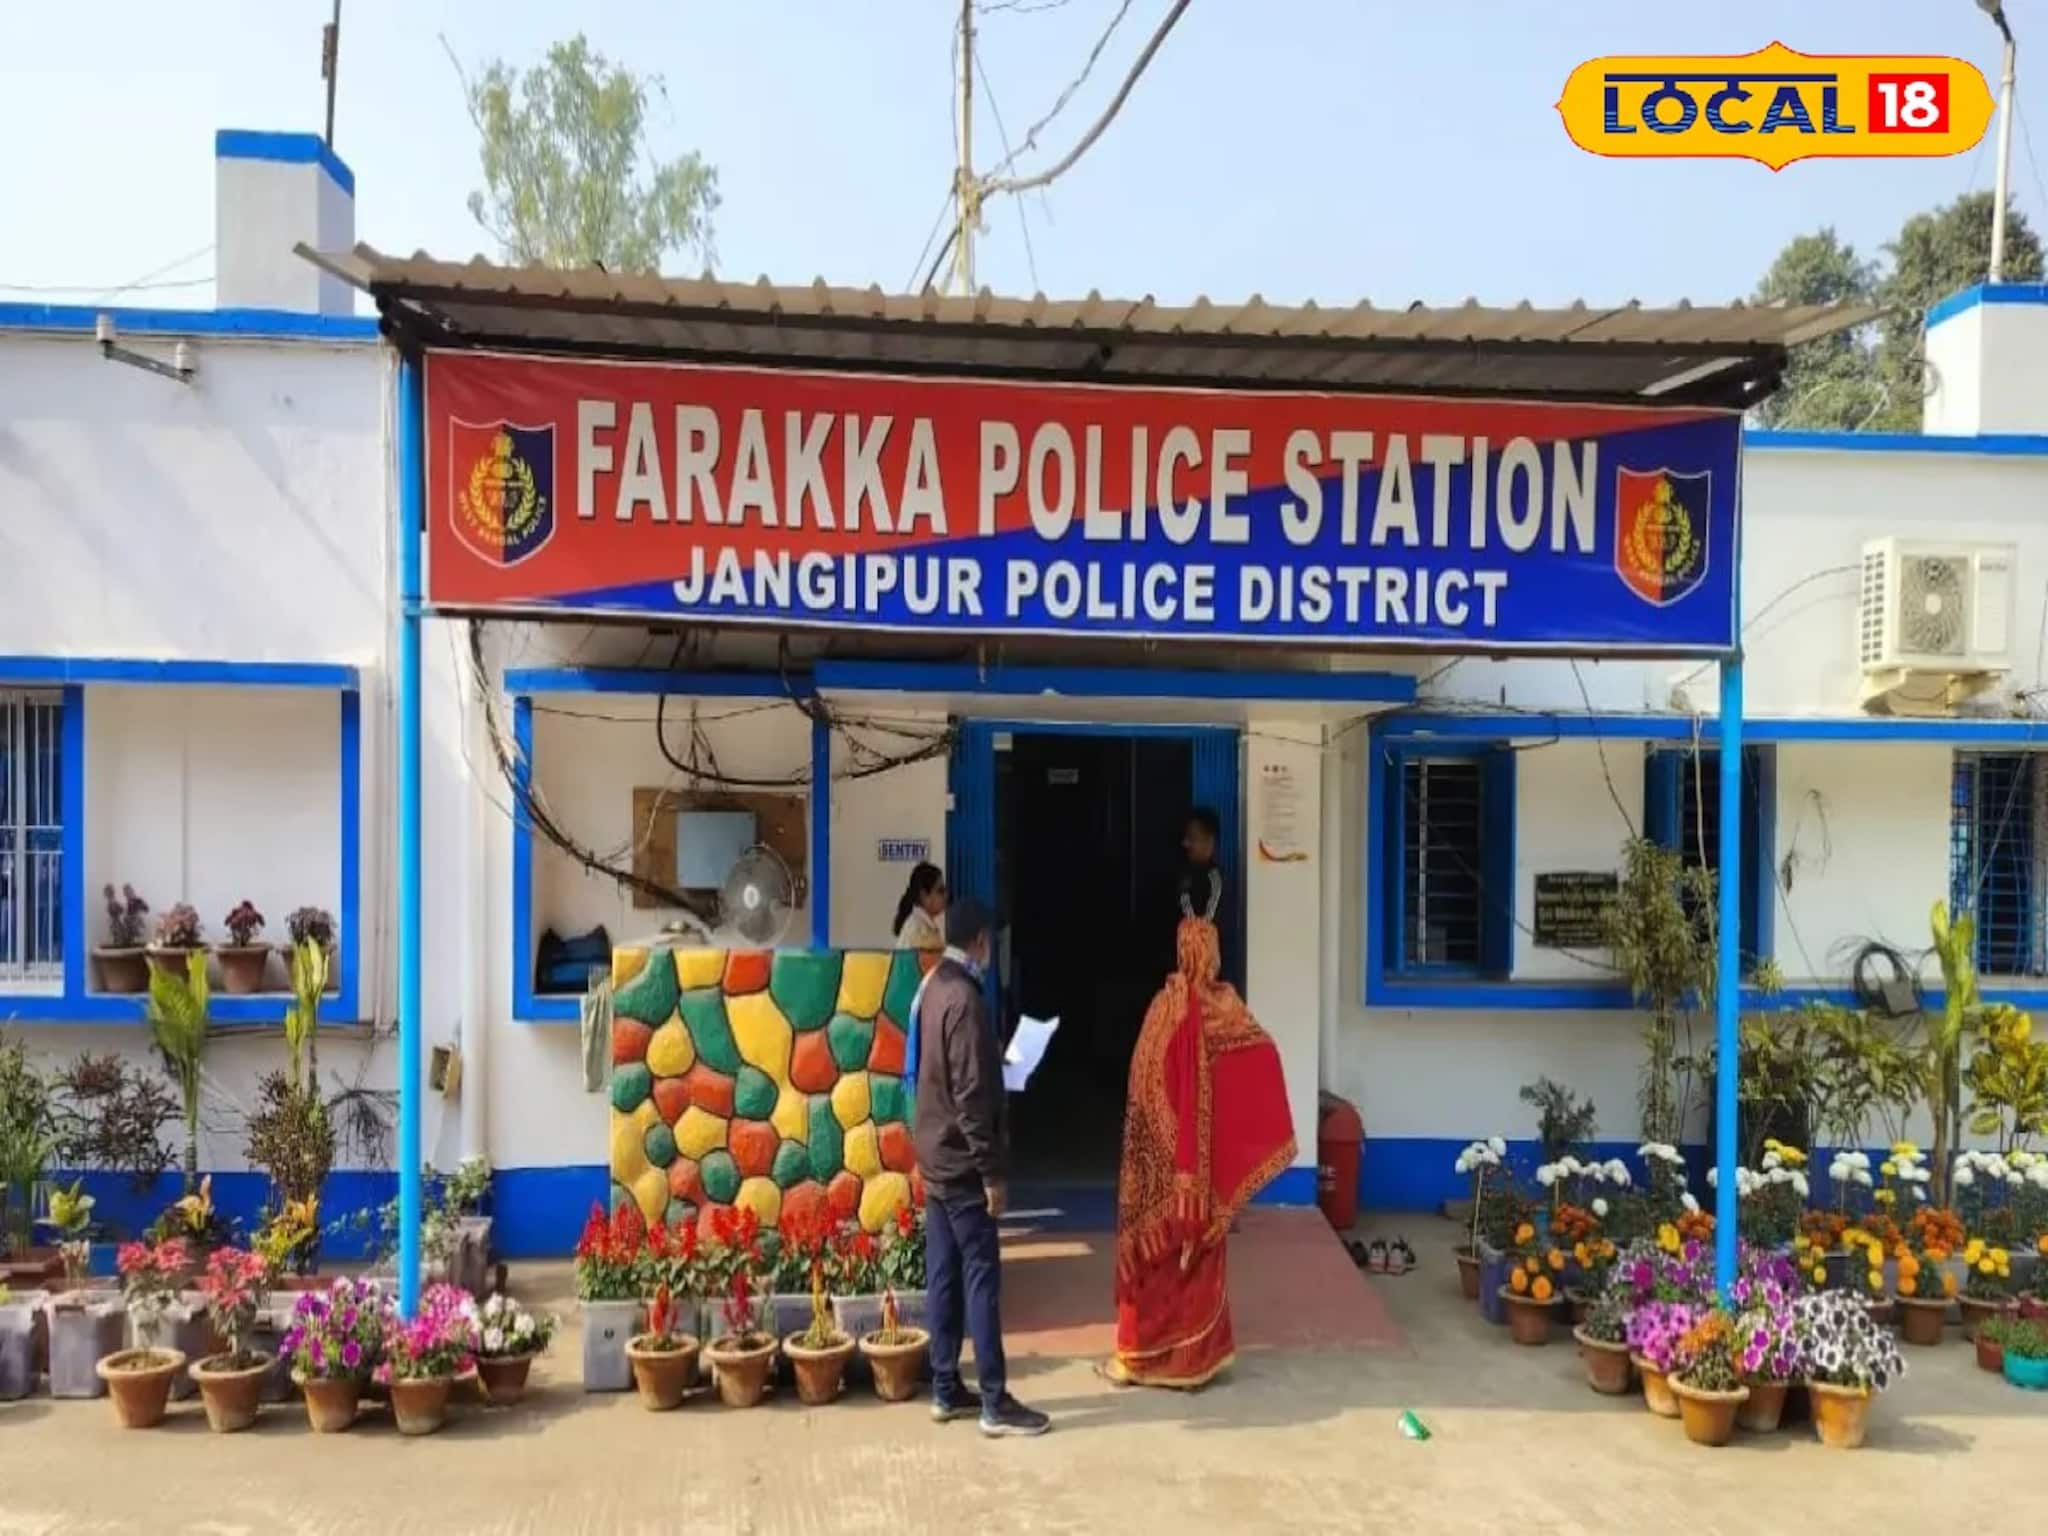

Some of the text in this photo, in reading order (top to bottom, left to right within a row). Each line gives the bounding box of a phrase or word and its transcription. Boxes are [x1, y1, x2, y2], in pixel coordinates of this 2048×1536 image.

[576, 399, 1599, 554] FARAKKA POLICE STATION
[673, 545, 1509, 627] JANGIPUR POLICE DISTRICT
[881, 843, 927, 858] SENTRY
